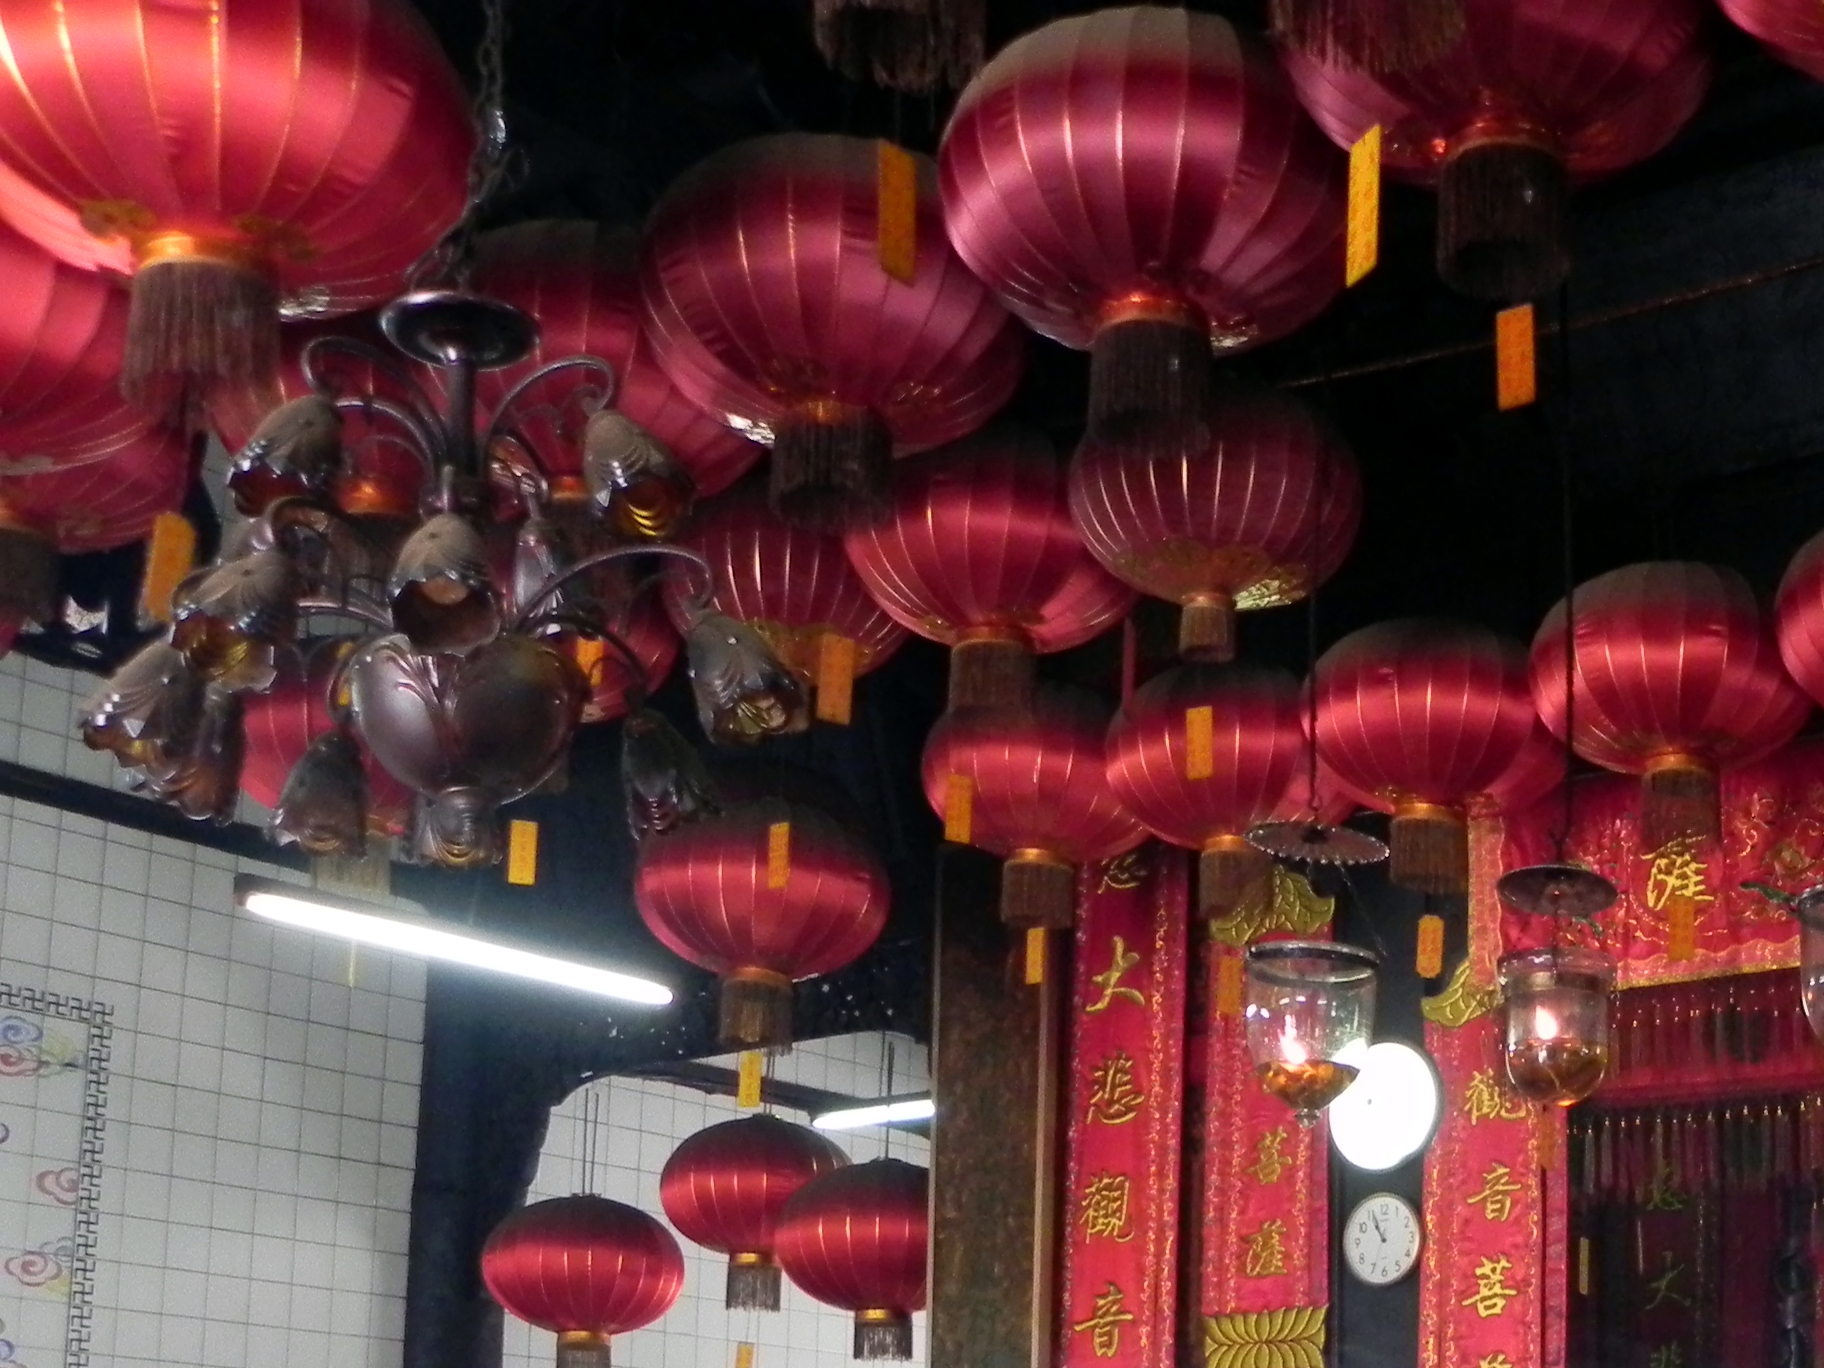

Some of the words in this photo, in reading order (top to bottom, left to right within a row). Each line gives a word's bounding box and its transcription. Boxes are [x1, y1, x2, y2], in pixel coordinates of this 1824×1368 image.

[1380, 1204, 1389, 1216] 12
[1360, 1221, 1367, 1233] 10
[1404, 1216, 1410, 1228] 2
[1354, 1237, 1361, 1248] 9
[1408, 1231, 1414, 1243] 3
[1359, 1252, 1365, 1265] 8
[1404, 1248, 1411, 1258] 4
[1370, 1262, 1377, 1274] 7
[1381, 1266, 1388, 1277] 6
[1395, 1260, 1401, 1272] 5
